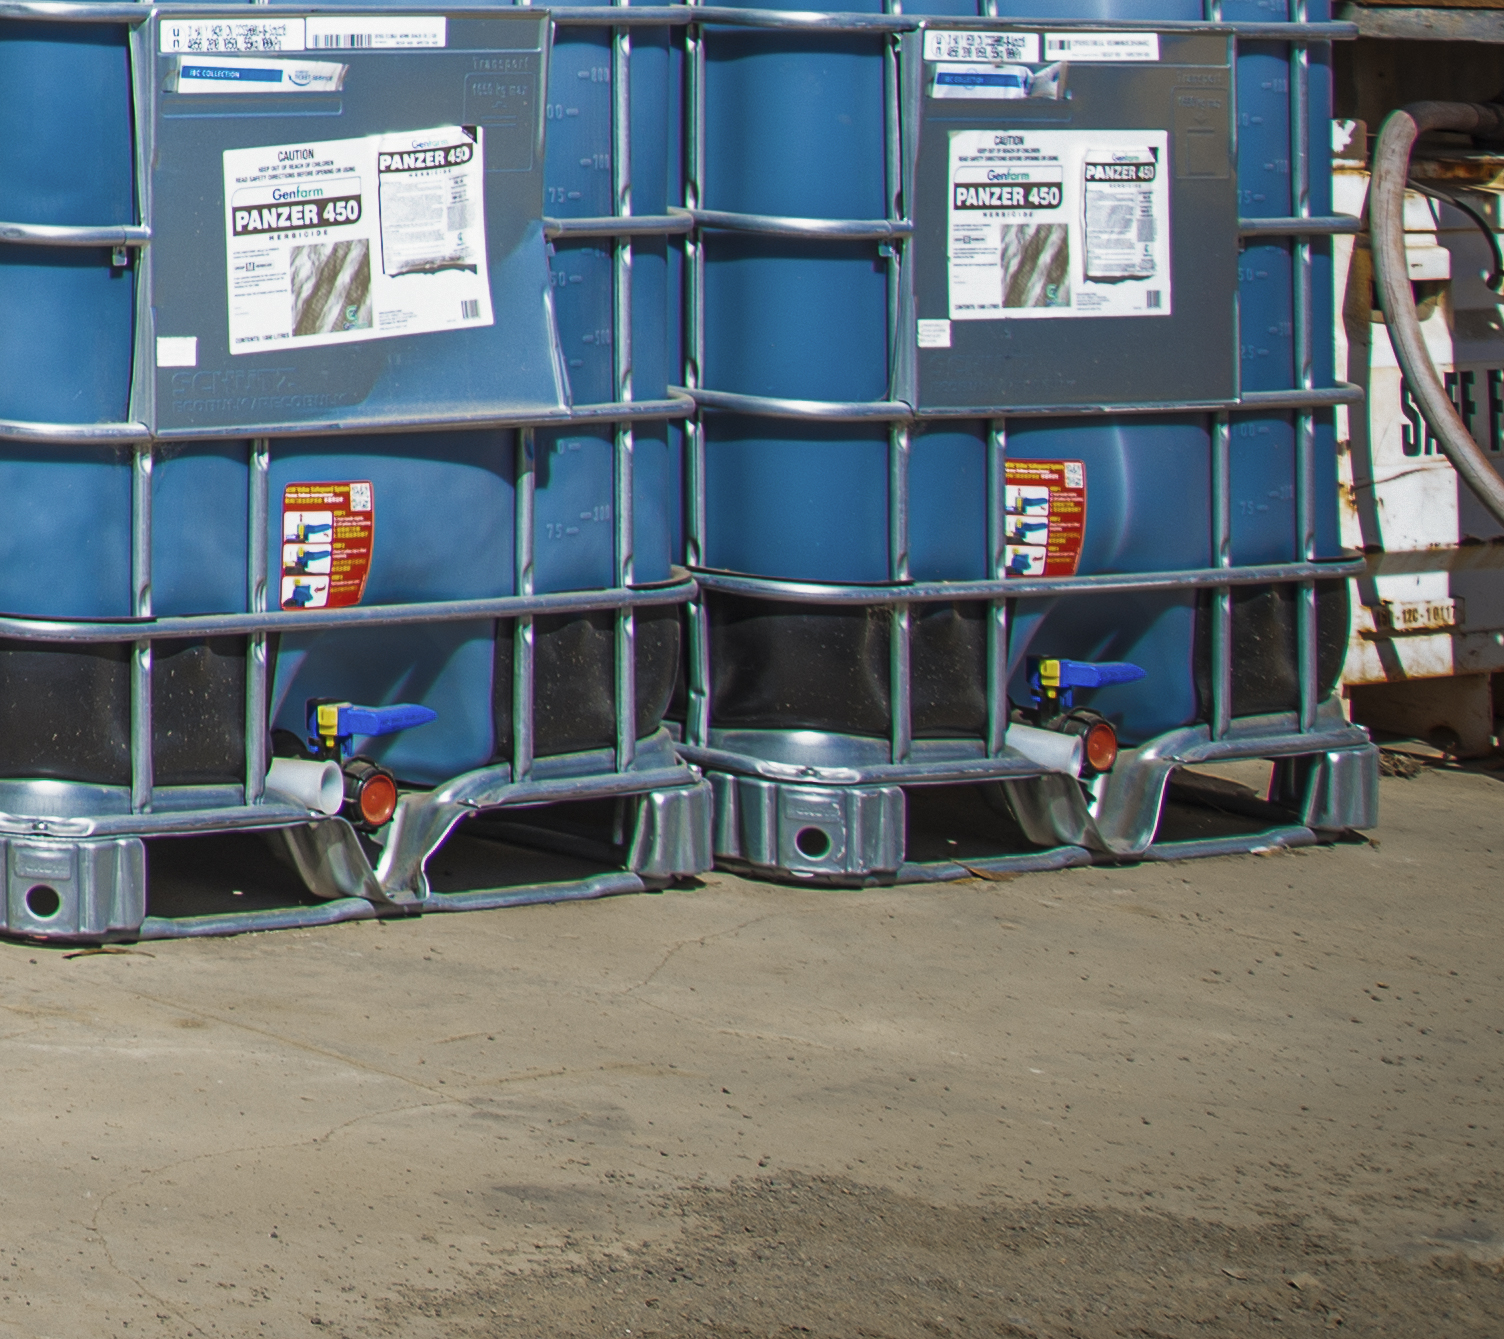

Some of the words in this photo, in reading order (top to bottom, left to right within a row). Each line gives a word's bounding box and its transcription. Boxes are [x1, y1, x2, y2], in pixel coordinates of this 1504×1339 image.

[277, 148, 315, 162] CAUTION
[379, 150, 445, 171] PANZER
[447, 147, 469, 164] 450
[987, 168, 1030, 182] Genfarm
[1085, 165, 1136, 180] PANZER
[272, 185, 323, 201] Genfarm
[955, 187, 1024, 206] PANZER
[1027, 186, 1060, 206] 450
[235, 204, 319, 232] PANZER
[322, 200, 359, 221] 450
[268, 229, 328, 241] HERBICIDE
[1400, 370, 1478, 457] SFE
